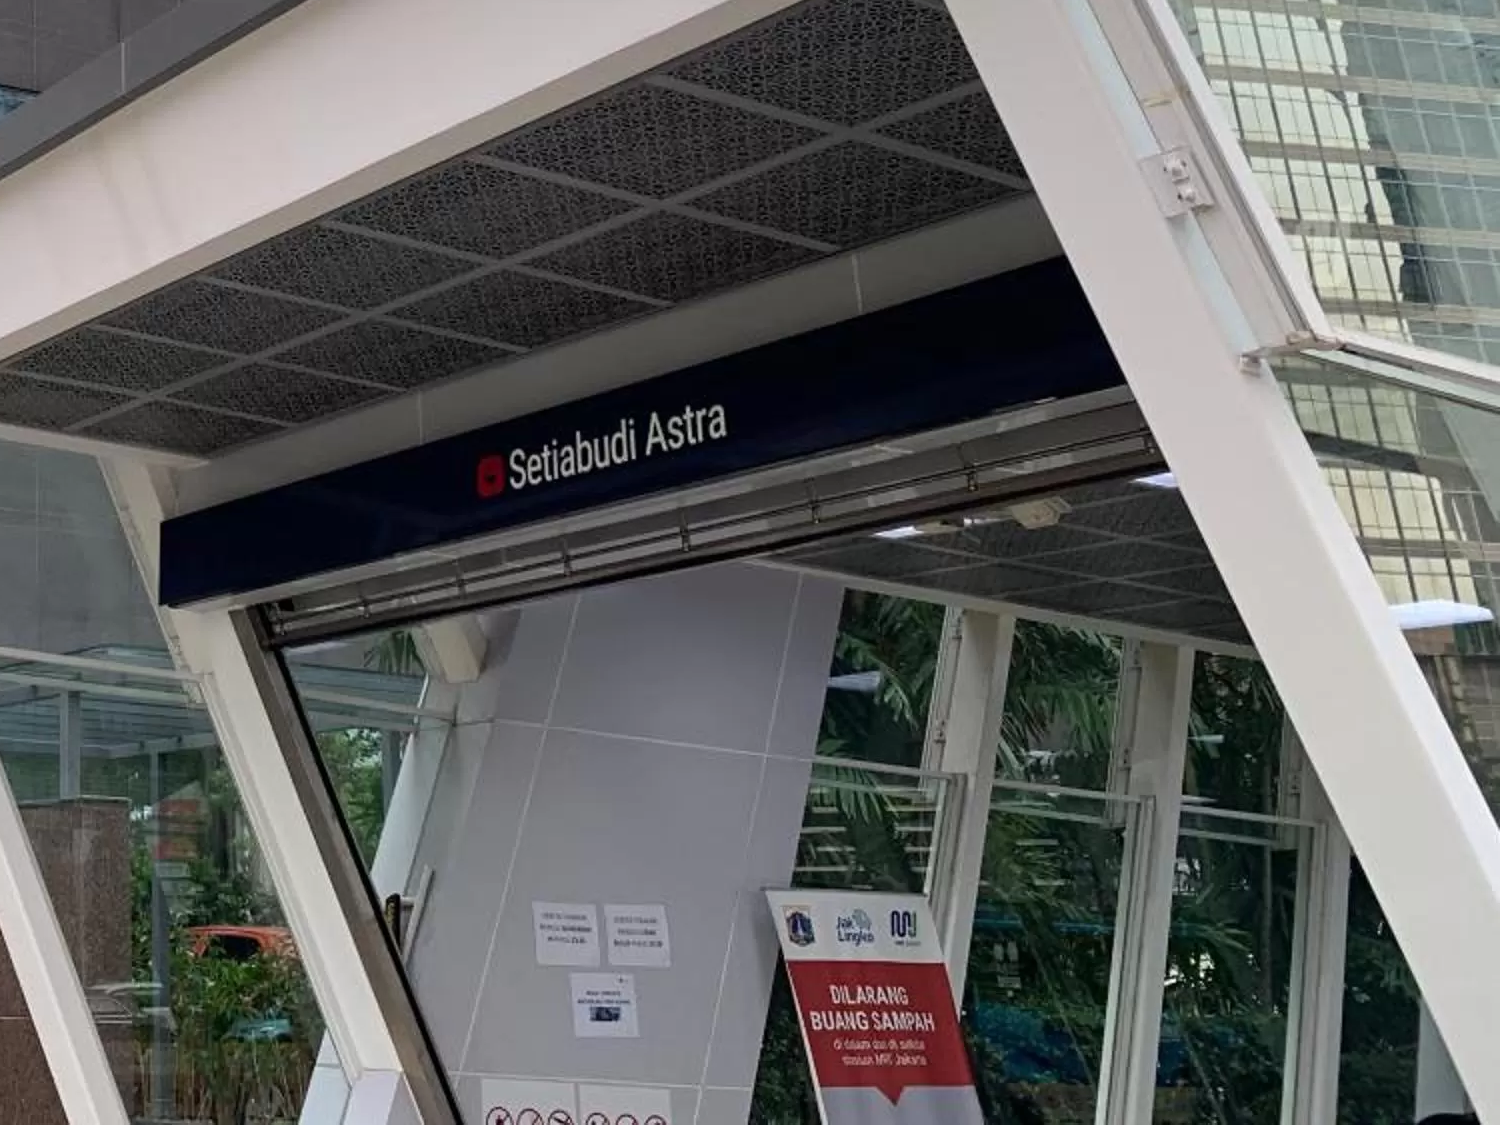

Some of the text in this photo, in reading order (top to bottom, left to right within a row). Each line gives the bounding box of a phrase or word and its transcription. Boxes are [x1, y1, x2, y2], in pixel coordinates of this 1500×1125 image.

[509, 403, 727, 490] Setiabudi Astra
[829, 984, 909, 1005] DILARANG
[809, 1010, 935, 1031] BUANG SAMPAH
